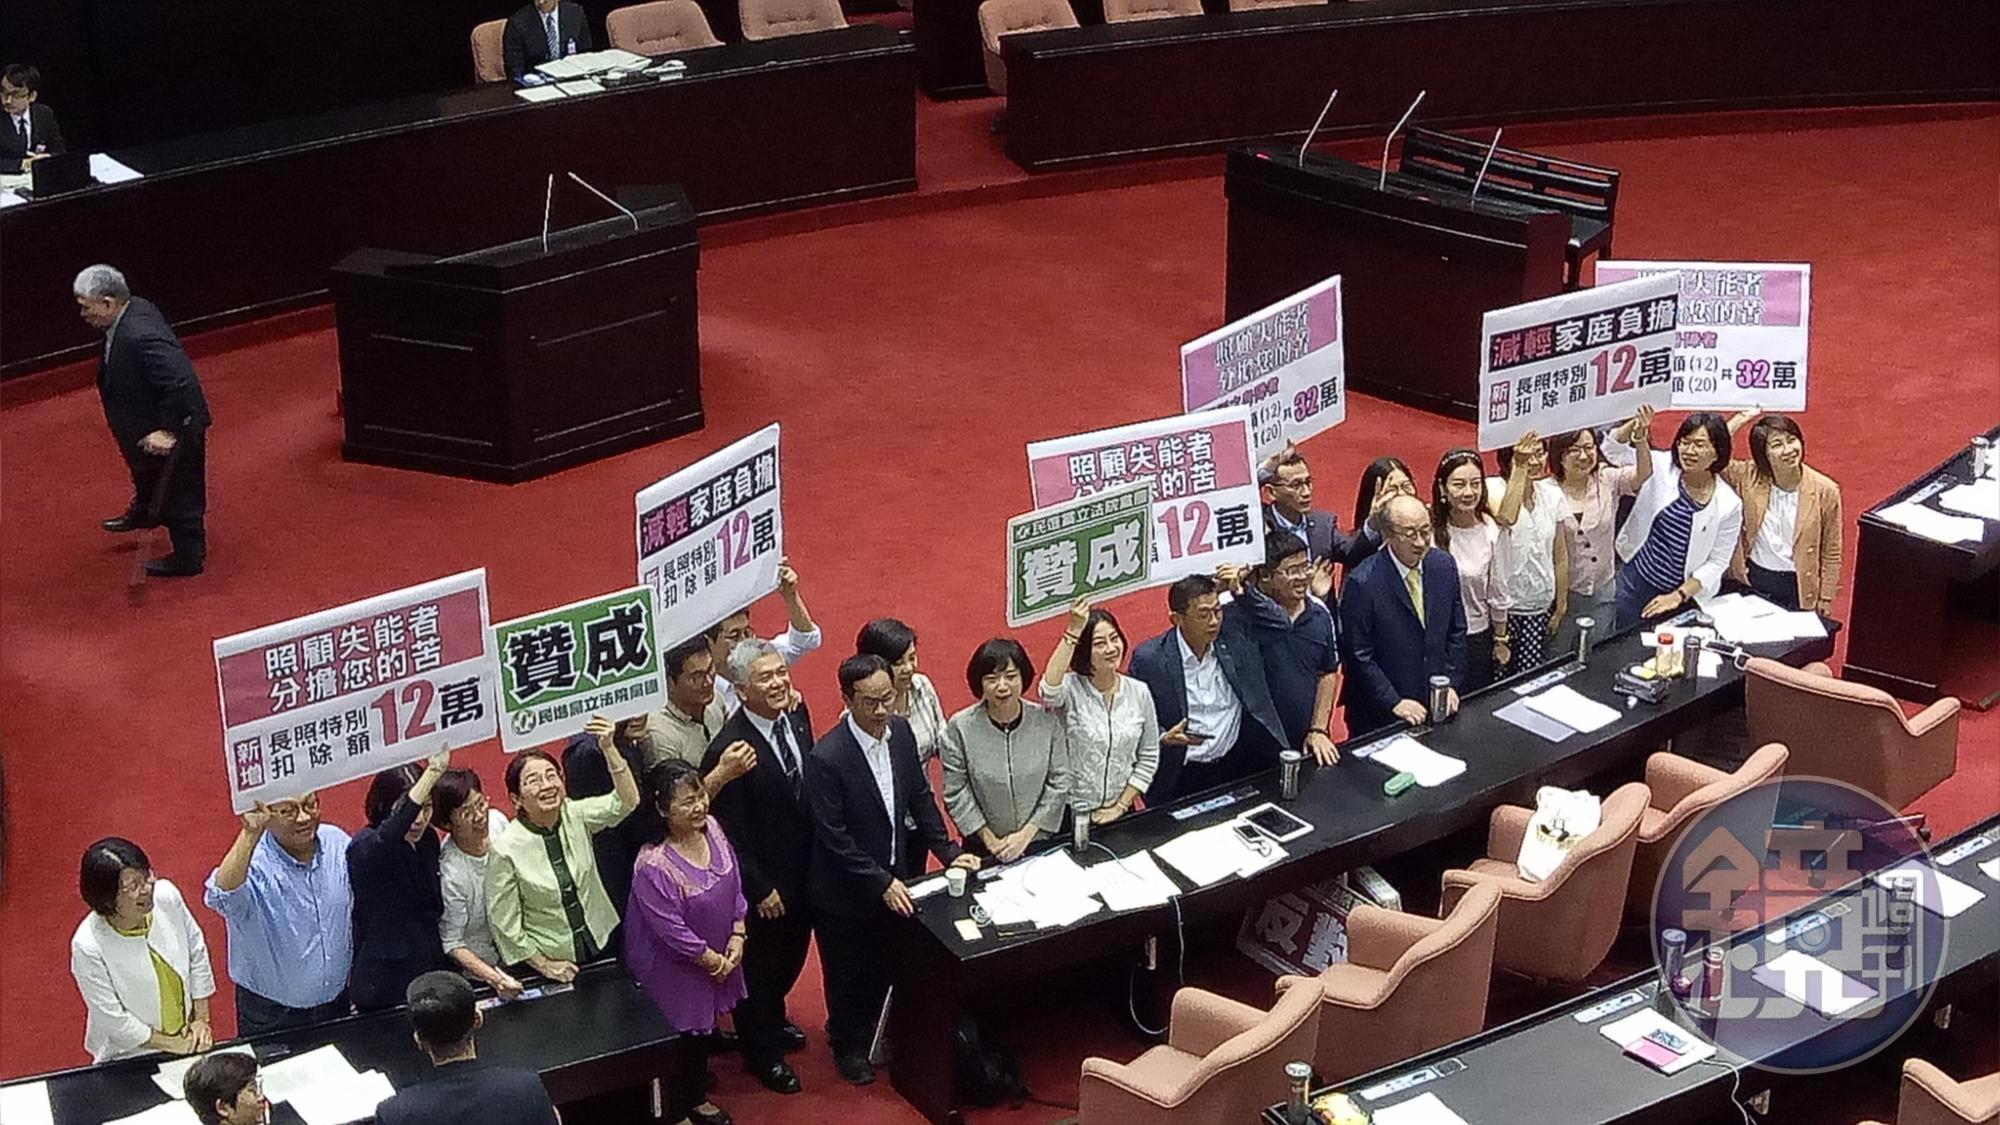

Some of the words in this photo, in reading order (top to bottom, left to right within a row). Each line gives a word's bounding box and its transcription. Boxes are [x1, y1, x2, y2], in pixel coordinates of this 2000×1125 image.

[1492, 300, 1675, 366] 減輕家庭負擔
[1515, 383, 1586, 416] 扣除額
[1516, 363, 1587, 397] 長照特別
[1590, 344, 1672, 397] 12萬
[1068, 432, 1213, 485] 照顧失能者
[643, 453, 774, 551] 減輕家庭負擔
[1157, 501, 1253, 560] 12萬
[663, 538, 716, 585] 長照特別
[717, 508, 776, 575] 12萬
[1021, 518, 1142, 607] 贊成
[266, 604, 440, 679] 照顧失能者
[505, 602, 650, 701] 贊成
[269, 637, 442, 712] 分擔您的苦
[270, 706, 367, 755] 長照特別
[370, 675, 484, 747] 12萬
[237, 741, 264, 787] 新增
[271, 731, 371, 779] 扣除額
